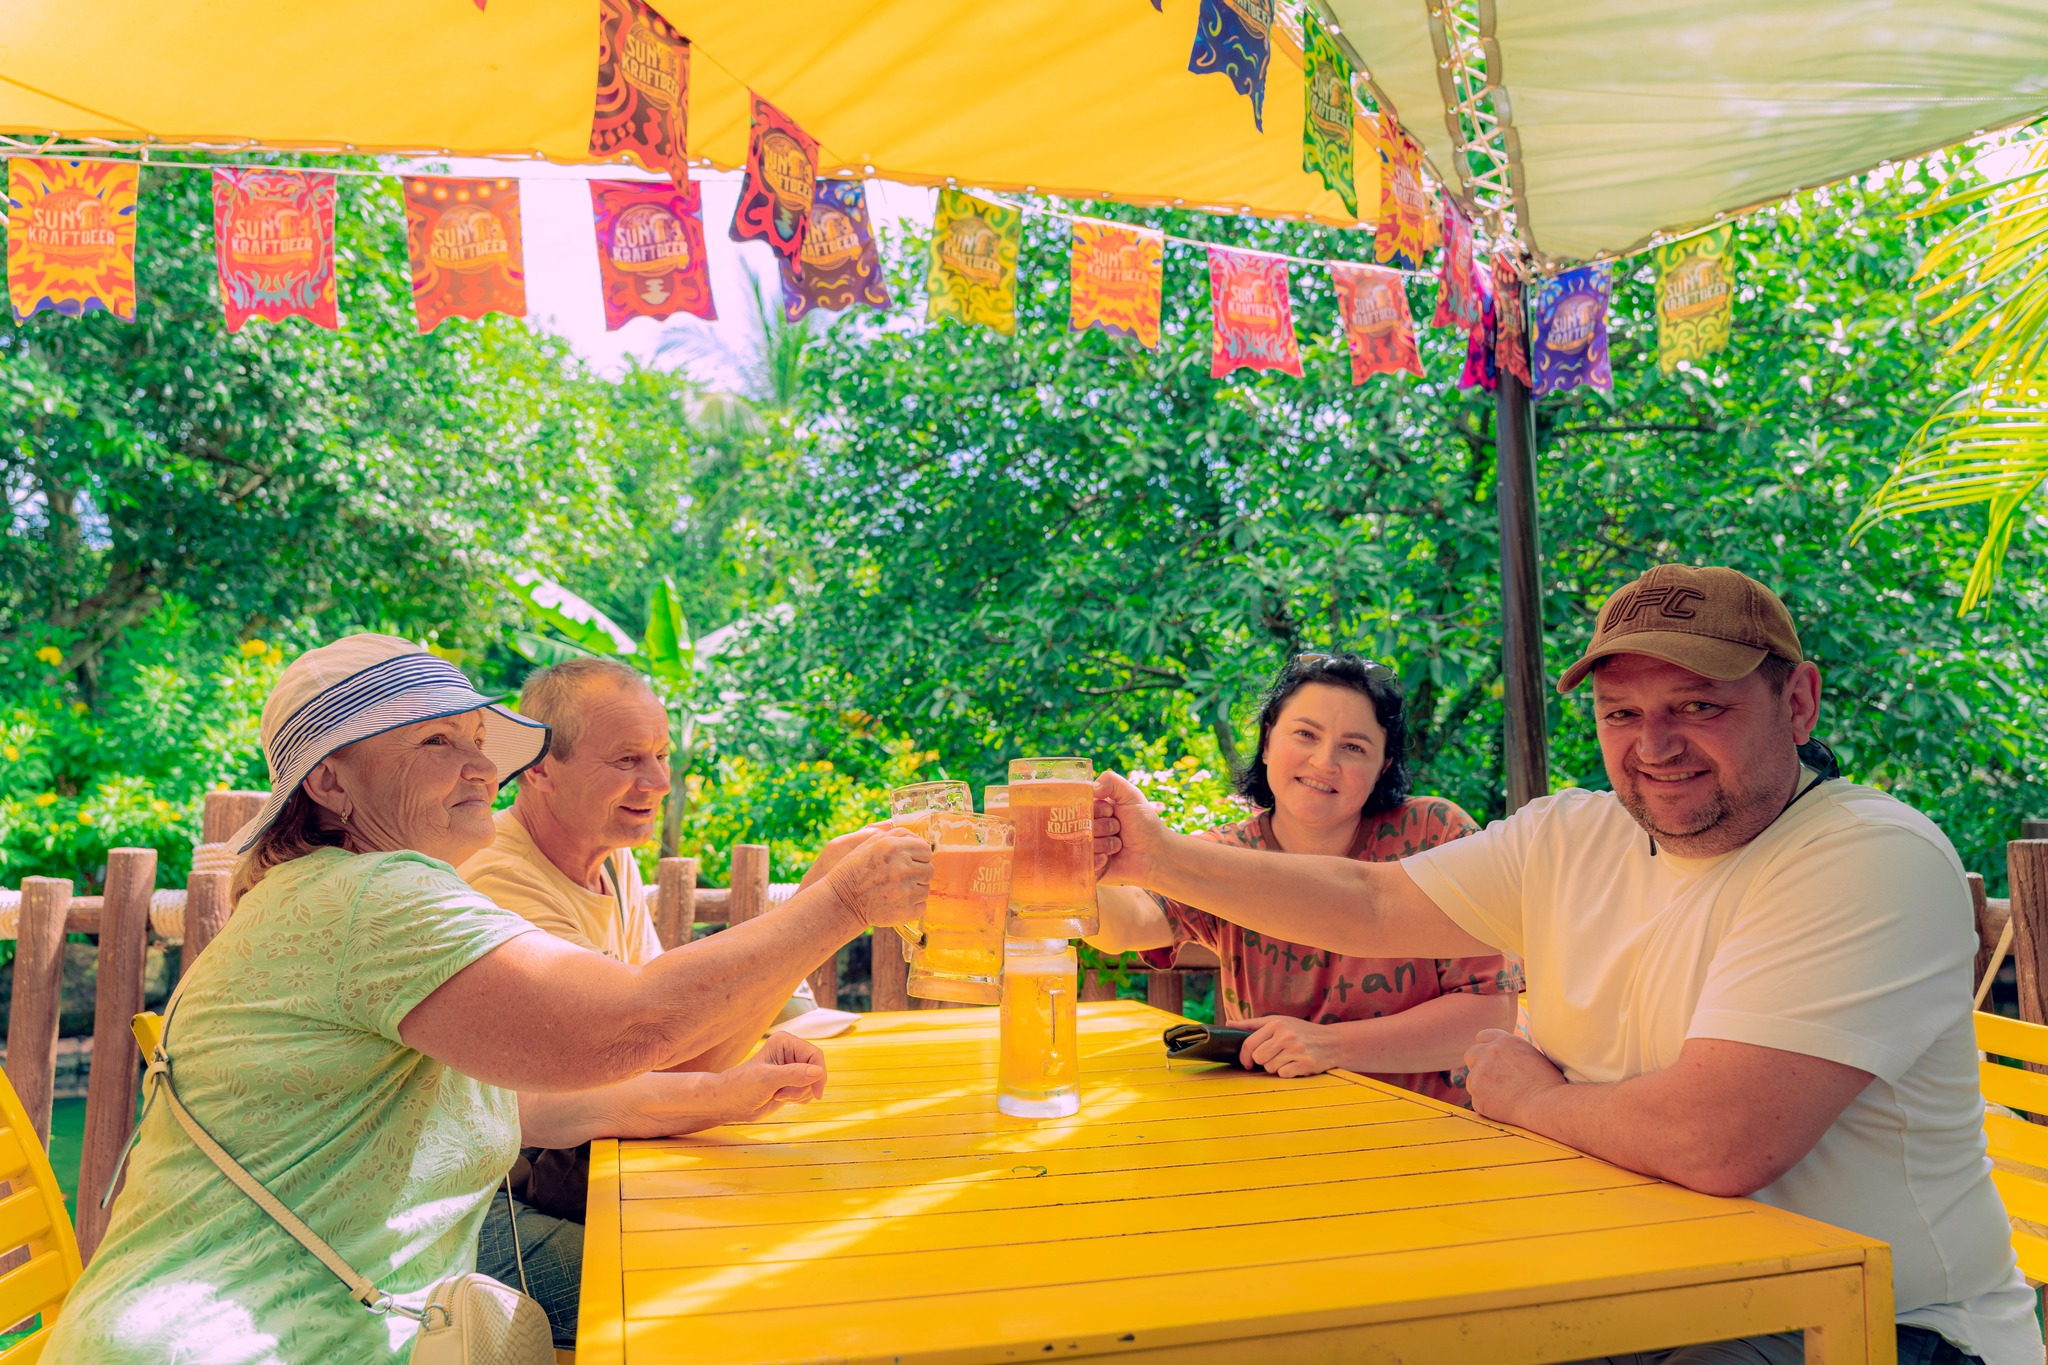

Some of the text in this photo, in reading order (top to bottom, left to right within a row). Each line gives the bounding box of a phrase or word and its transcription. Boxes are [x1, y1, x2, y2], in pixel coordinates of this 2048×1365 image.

[626, 34, 658, 68] SUN
[33, 208, 75, 230] SUN
[235, 218, 274, 240] SUN
[28, 226, 116, 246] KRAFTBEER
[231, 236, 313, 254] KRAFTBEER
[433, 225, 474, 247] SUN
[614, 221, 652, 248] SUN
[430, 239, 509, 260] KRAFTBEER
[612, 240, 689, 263] KRAFTBEER
[1093, 247, 1118, 268] SUN
[1230, 285, 1253, 303] SUN
[1666, 278, 1694, 299] SUN
[1603, 586, 1705, 633] UFC
[1050, 807, 1076, 822] SUN
[977, 866, 1001, 882] SUN
